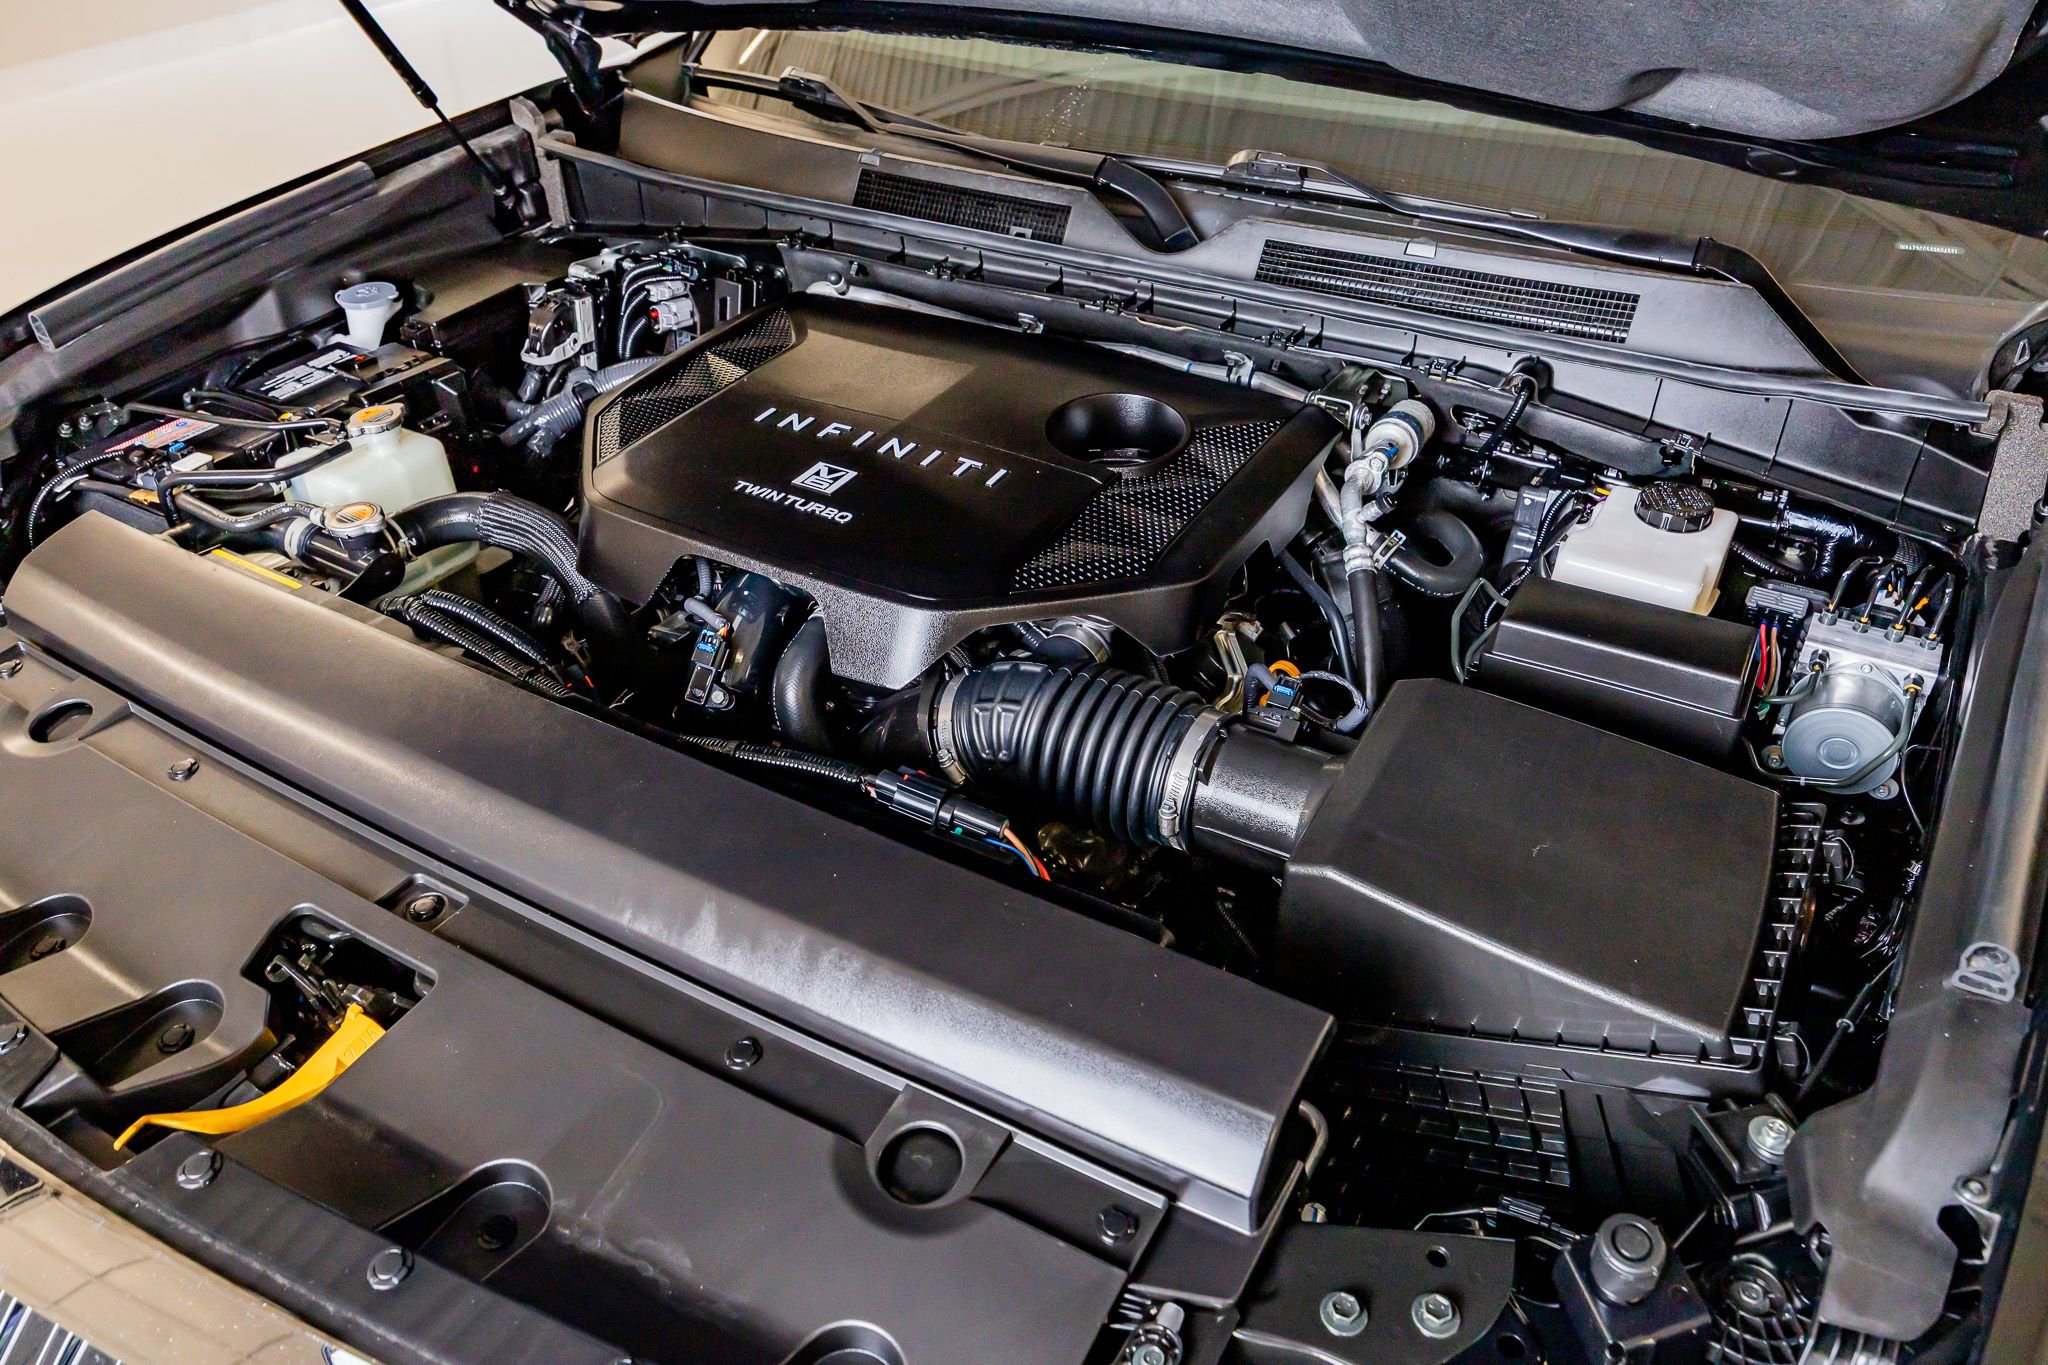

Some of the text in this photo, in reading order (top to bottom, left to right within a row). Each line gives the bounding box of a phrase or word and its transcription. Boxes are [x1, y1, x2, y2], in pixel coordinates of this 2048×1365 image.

[754, 407, 1008, 487] INFINITI
[800, 463, 850, 491] V6
[733, 480, 853, 524] TWIN TURBO
